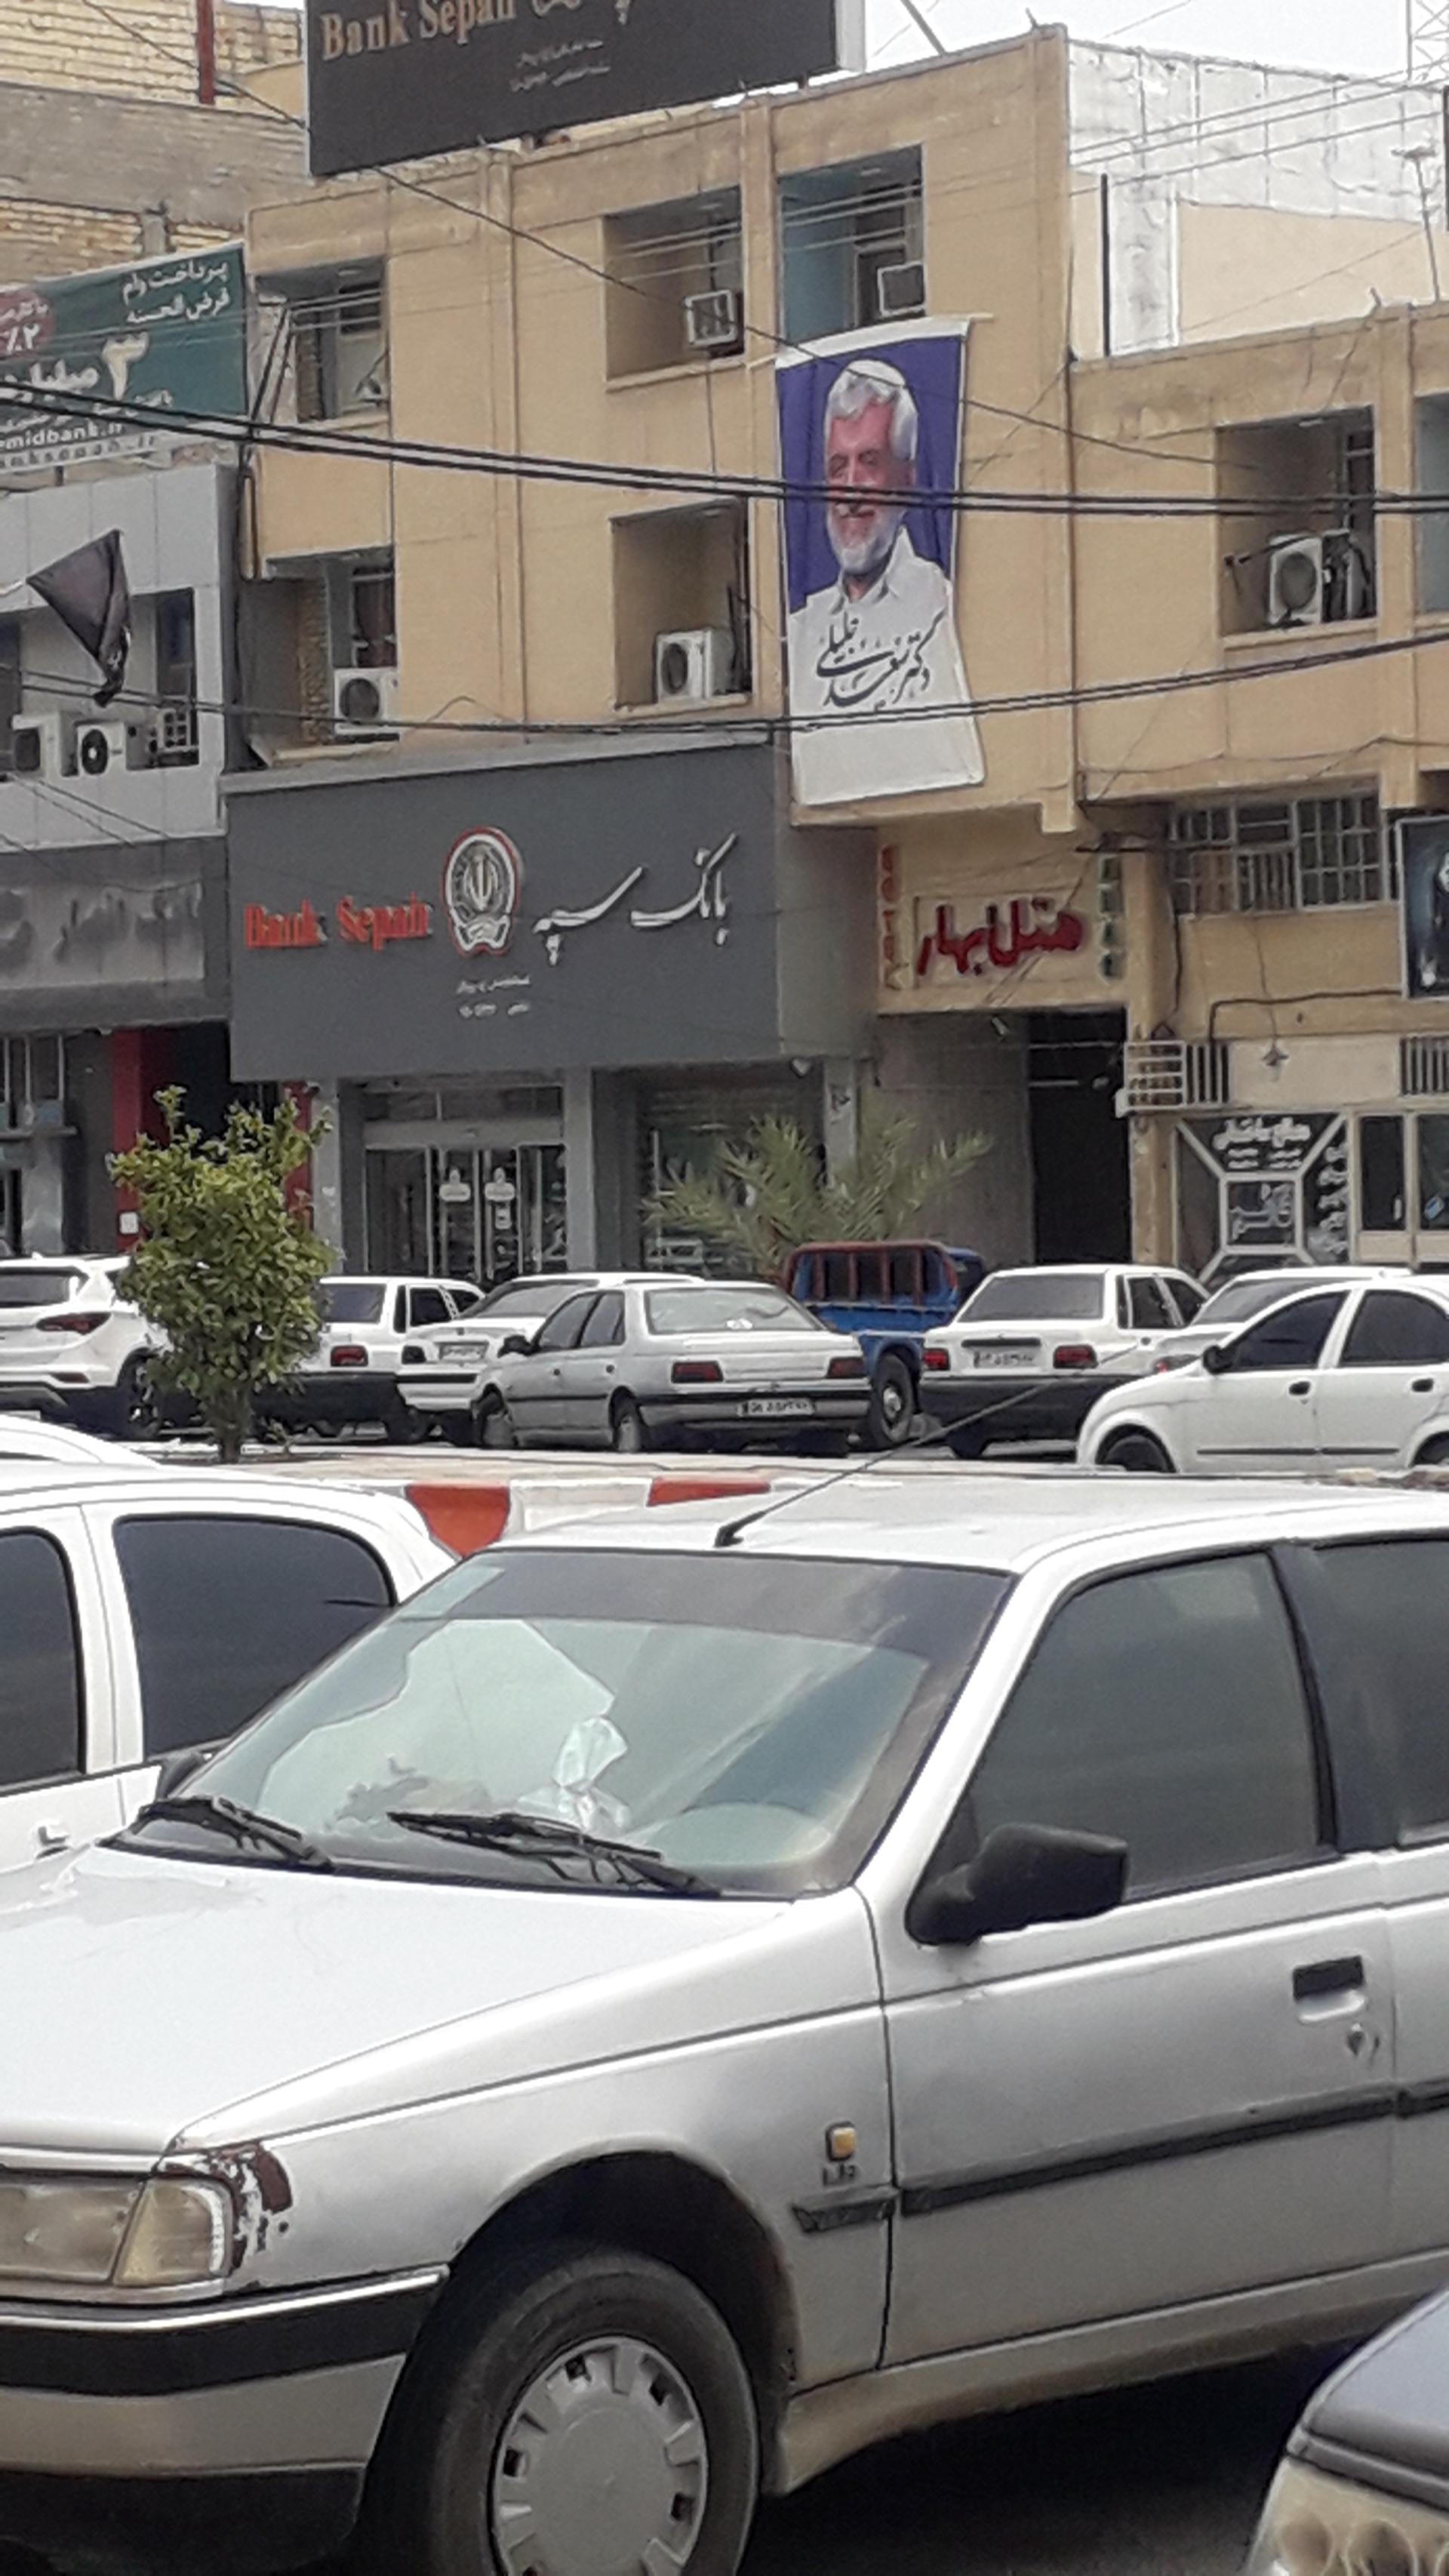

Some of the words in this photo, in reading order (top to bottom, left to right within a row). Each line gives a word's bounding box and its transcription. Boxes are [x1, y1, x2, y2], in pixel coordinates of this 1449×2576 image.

[320, 0, 411, 60] Bank
[148, 259, 228, 291] پرداخت
[531, 865, 646, 966] سپه
[631, 832, 738, 946] بانک
[244, 898, 328, 949] Bank
[335, 892, 434, 951] Sepah
